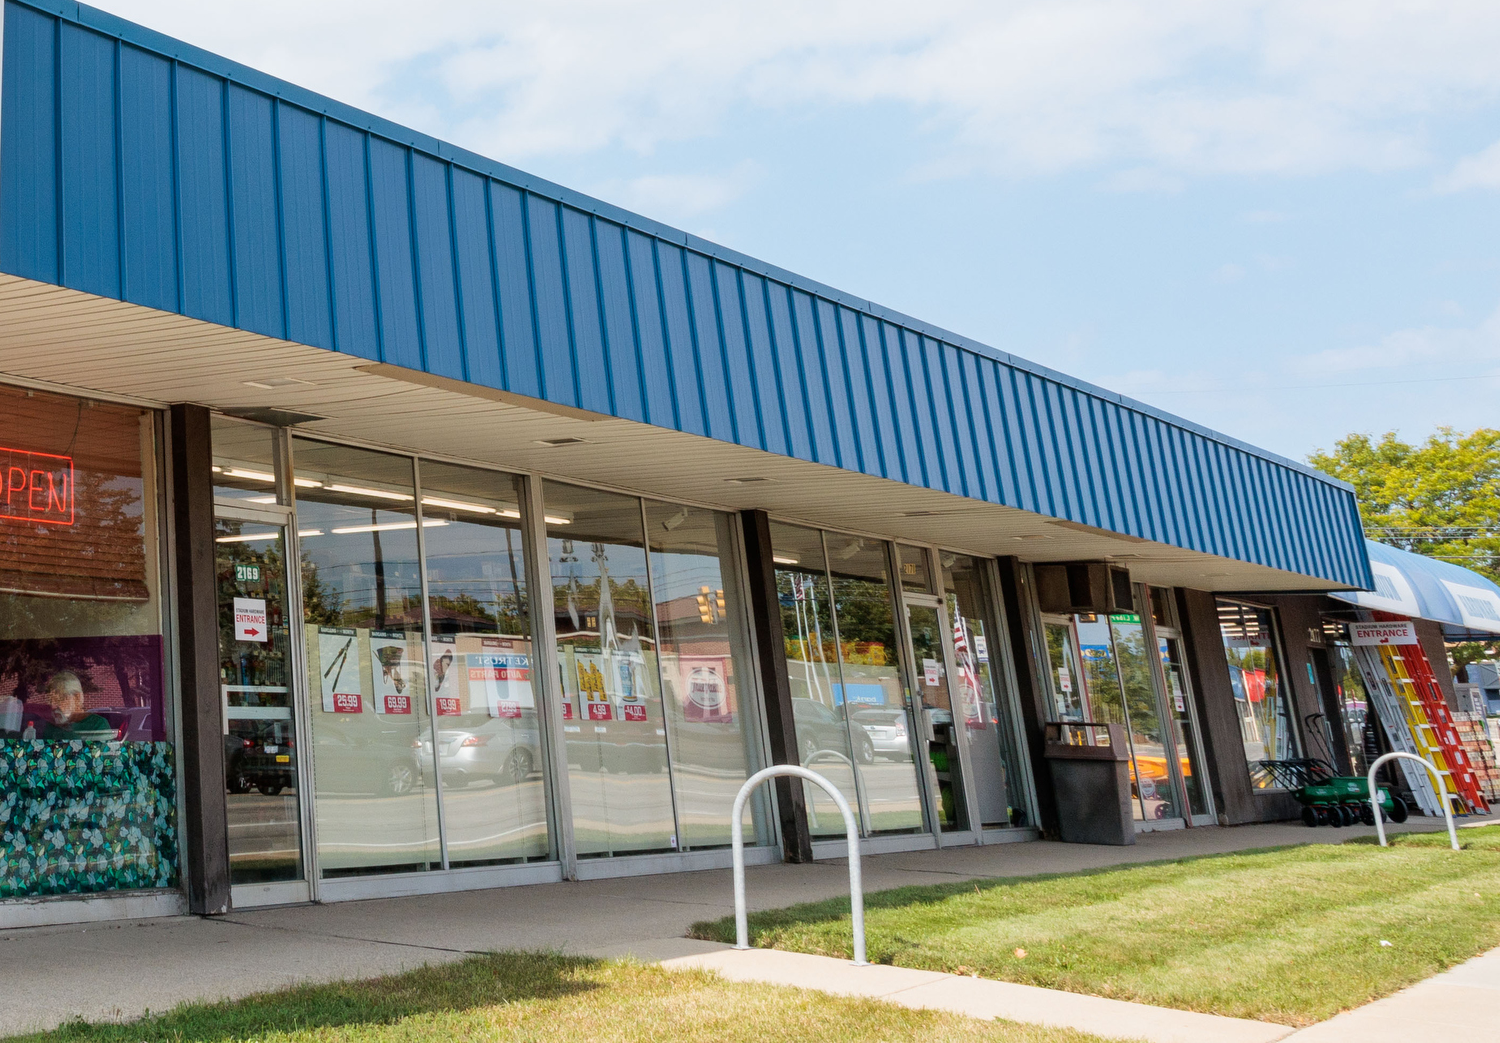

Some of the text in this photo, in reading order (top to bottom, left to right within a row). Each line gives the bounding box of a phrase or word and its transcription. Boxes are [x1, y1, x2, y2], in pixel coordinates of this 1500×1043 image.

[237, 566, 260, 580] 2169
[236, 614, 266, 625] ENTRANCE
[1357, 628, 1409, 638] ENTRANCE
[337, 694, 358, 707] 25.99
[387, 696, 407, 709] 69.99
[439, 698, 457, 710] 19.99
[593, 704, 607, 715] 4.99
